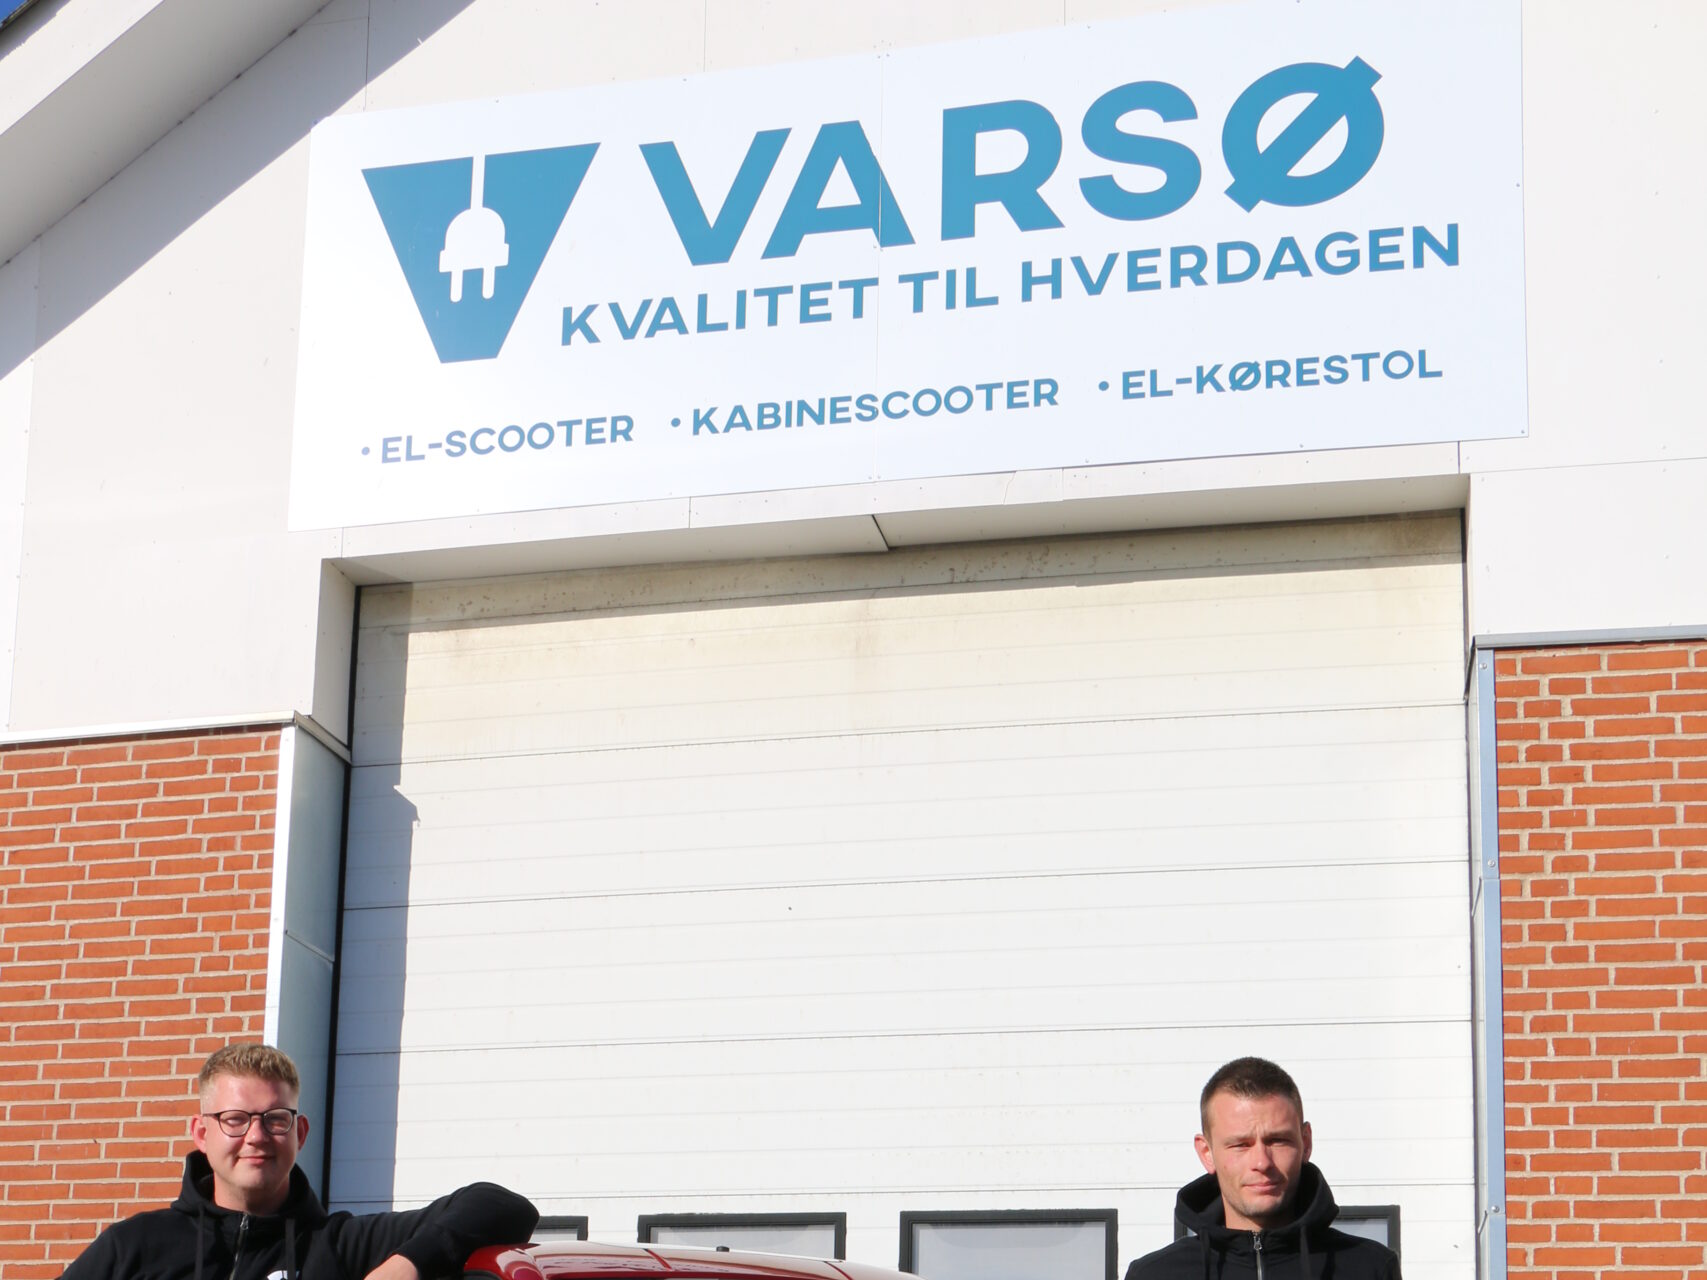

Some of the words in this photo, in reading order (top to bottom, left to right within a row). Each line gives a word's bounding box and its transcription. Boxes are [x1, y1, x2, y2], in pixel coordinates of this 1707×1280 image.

[638, 55, 1385, 267] VARSØ
[561, 276, 879, 347] KVALITET
[897, 266, 999, 314] TIL
[1020, 223, 1459, 304] HVERDAGEN
[1121, 347, 1443, 401] EL-KØRESTOL
[691, 377, 1059, 437] KABINESCOOTER
[381, 414, 634, 464] EL-SCOOTER
